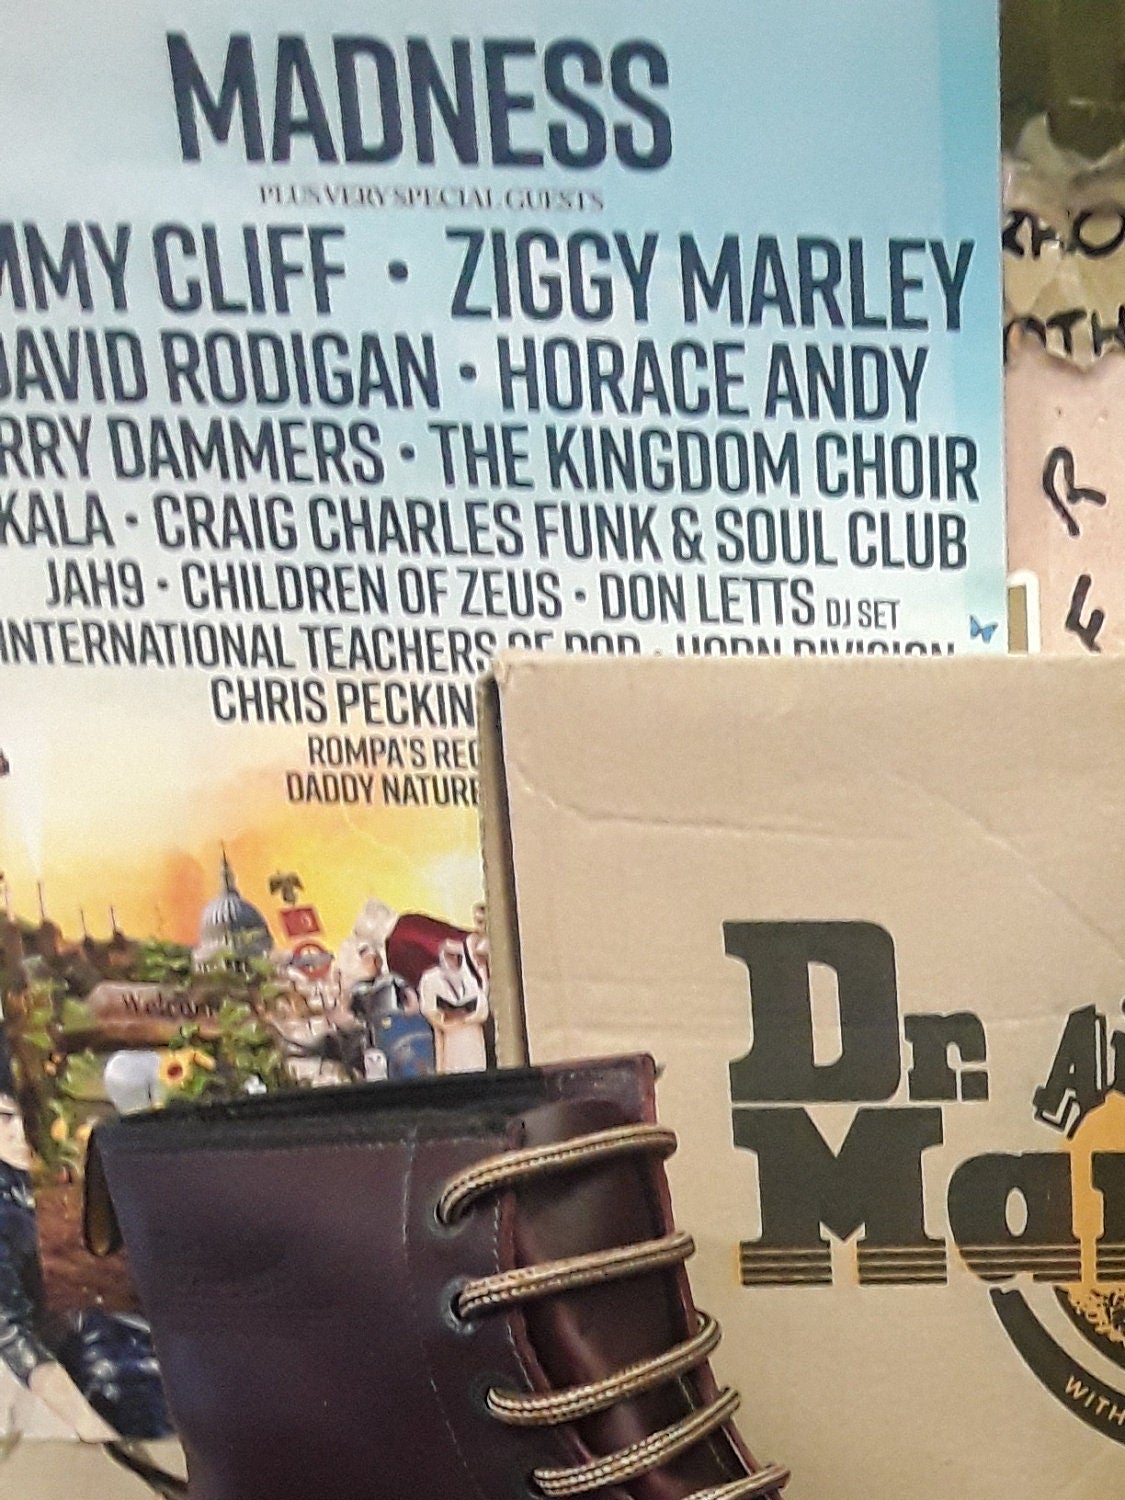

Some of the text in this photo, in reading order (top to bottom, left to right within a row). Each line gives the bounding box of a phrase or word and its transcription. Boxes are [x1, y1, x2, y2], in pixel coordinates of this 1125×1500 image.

[165, 32, 673, 170] MADNESS
[394, 187, 492, 210] SPECIAL
[504, 189, 605, 212] GUESTS
[152, 222, 346, 315] CLIFF
[446, 227, 659, 324] ZIGGY
[678, 232, 976, 332] MARLEY
[161, 330, 440, 410] RODIGAN
[497, 334, 750, 419] HORACE
[764, 343, 929, 424] ANDY
[106, 415, 386, 485] DAMMERS
[428, 422, 535, 490] THE
[545, 424, 801, 498] KINGDOM
[816, 431, 980, 503] CHOIR
[152, 491, 299, 552] CRAIG
[309, 493, 524, 560] CHARLES
[534, 501, 663, 565] FUNK
[672, 505, 704, 565] &
[715, 506, 840, 568] SOUL
[848, 510, 969, 570] CLUB
[45, 556, 901, 631] JAH9 CHILDREN OF ZEUS DON LETTS DJ SET
[0, 619, 298, 672] INTERNATIONAL
[300, 622, 497, 675] TEACHERS
[210, 677, 477, 729] CHRIS PECKIN
[286, 773, 374, 804] DADDY
[307, 735, 427, 769] ROMPA'S
[722, 919, 990, 1102] Dr.
